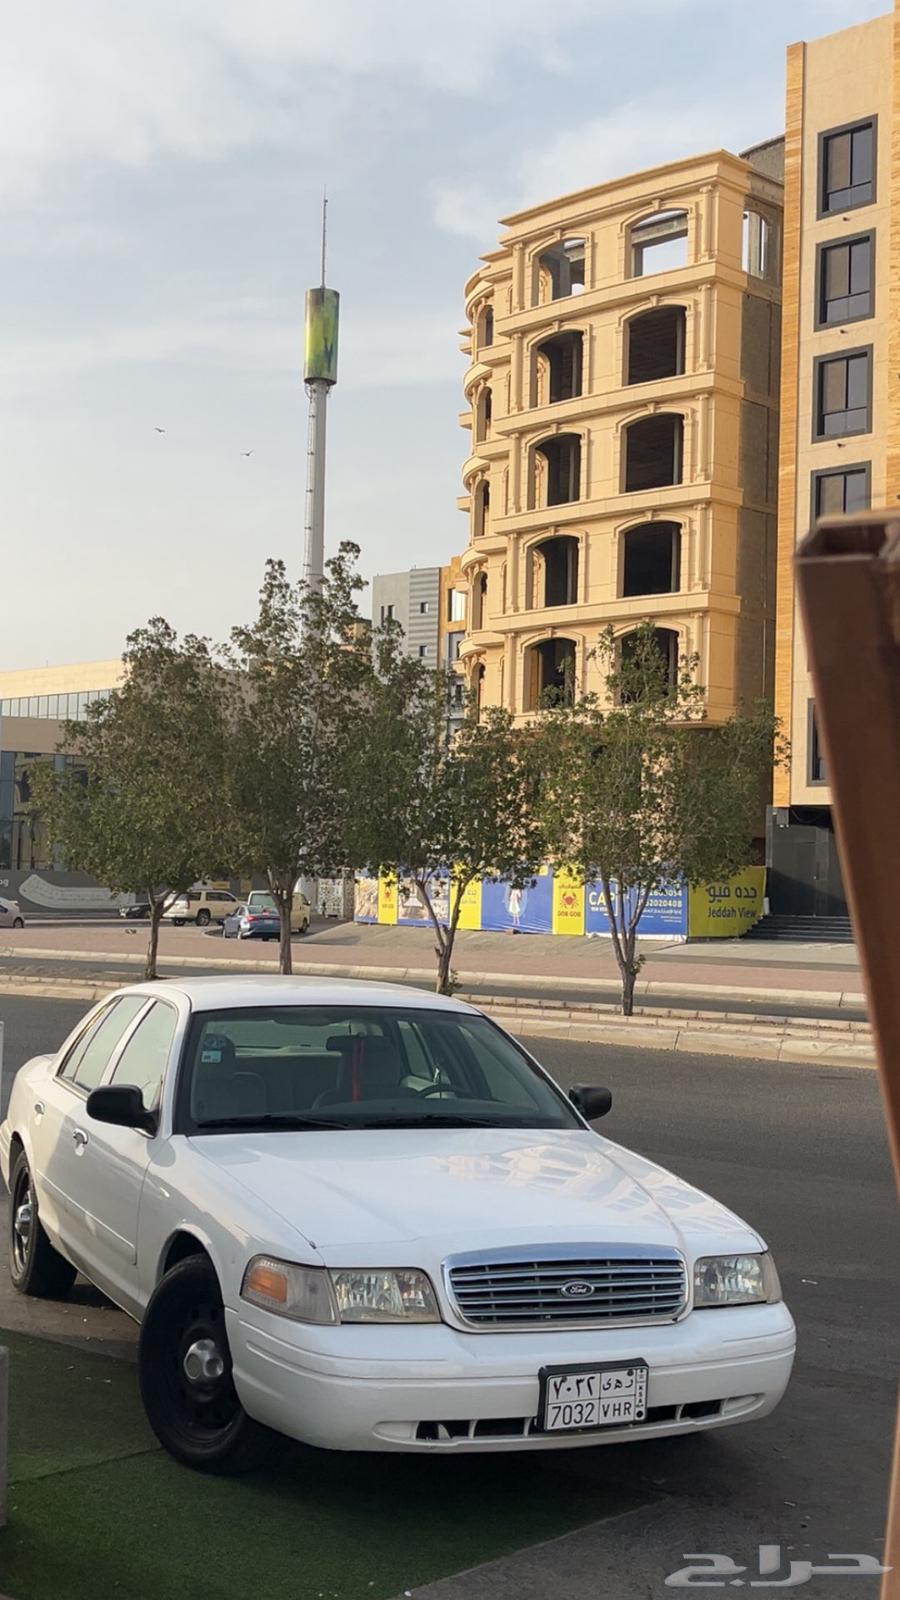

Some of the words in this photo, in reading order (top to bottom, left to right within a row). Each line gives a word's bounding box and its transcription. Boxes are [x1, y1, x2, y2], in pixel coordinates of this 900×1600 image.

[708, 906, 736, 918] Jeddah
[738, 906, 757, 918] View
[551, 1402, 595, 1427] 7032
[602, 1402, 632, 1417] VHR
